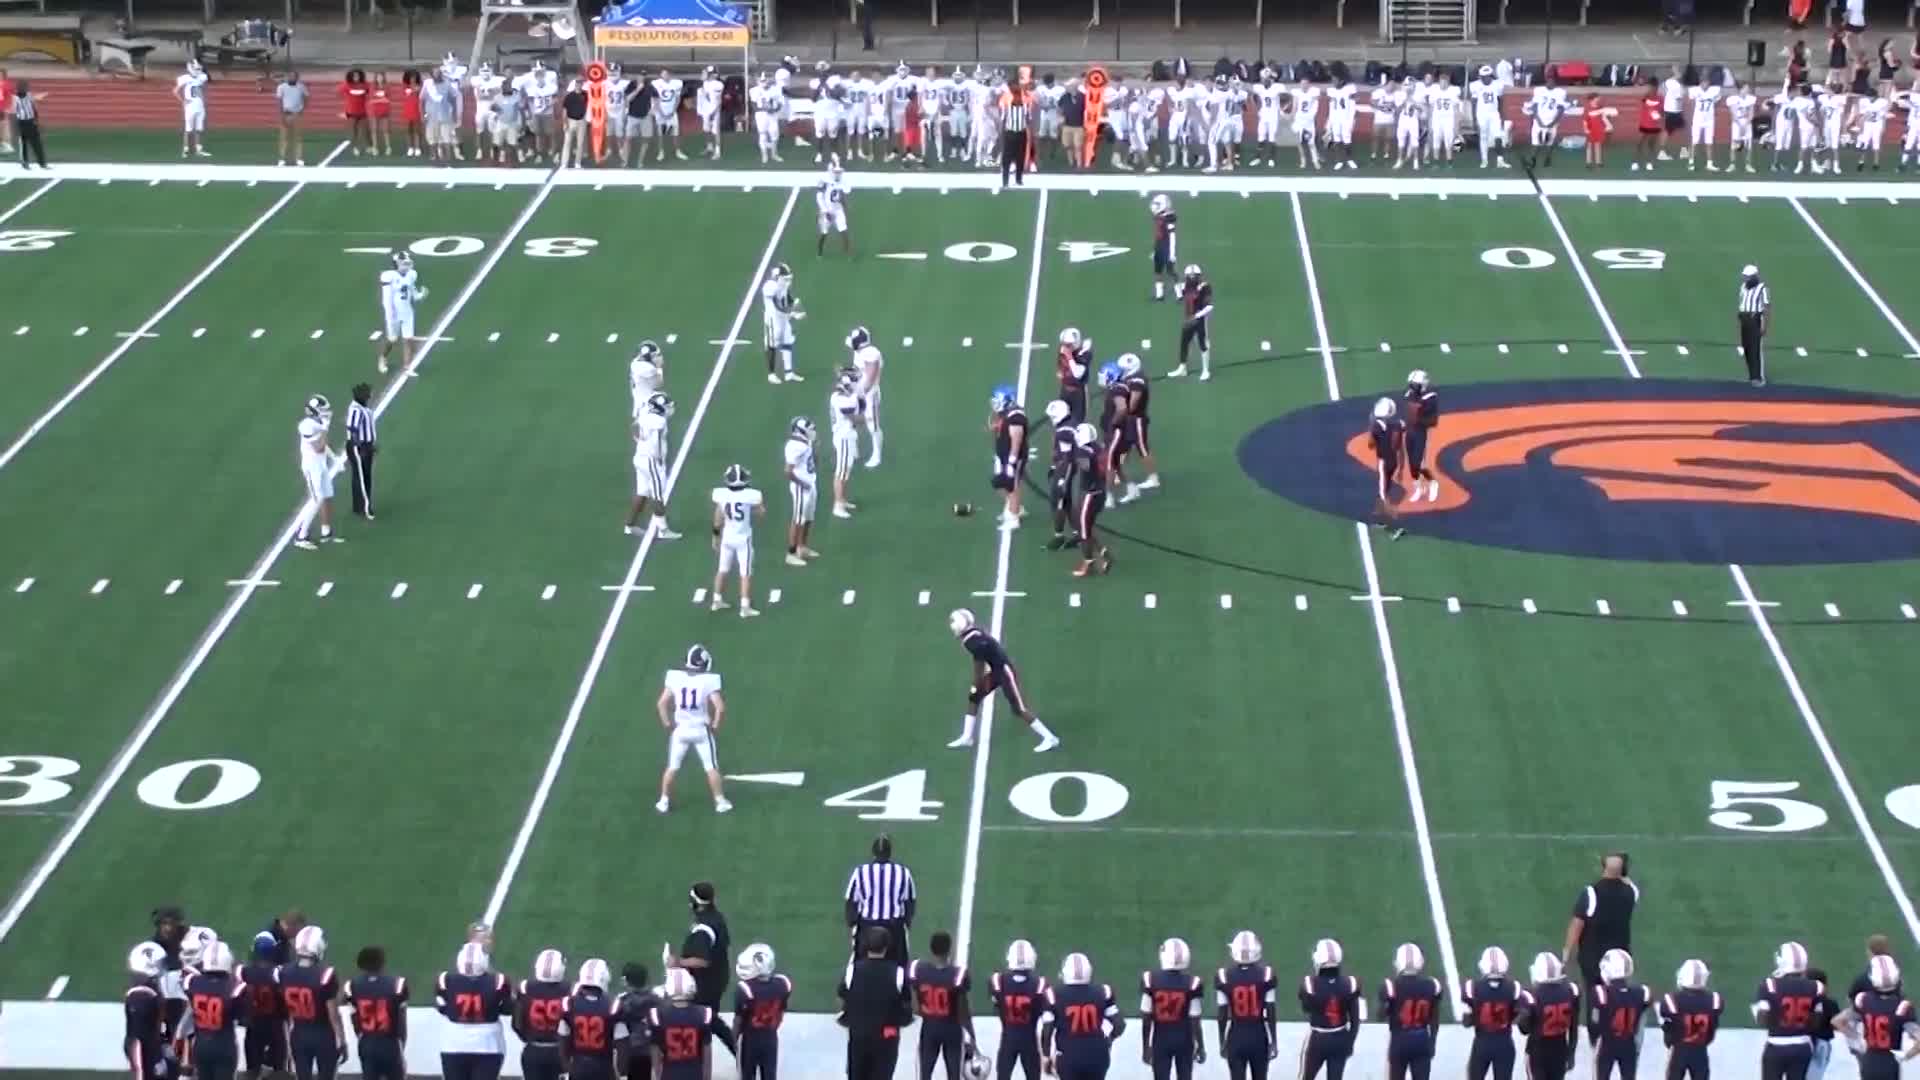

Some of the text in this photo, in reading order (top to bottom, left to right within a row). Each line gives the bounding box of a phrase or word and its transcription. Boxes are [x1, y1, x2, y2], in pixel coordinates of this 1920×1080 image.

[724, 501, 745, 522] 45
[679, 687, 700, 711] 11
[193, 993, 225, 1031] 58
[357, 999, 391, 1032] 54
[455, 992, 485, 1019] 71
[919, 984, 950, 1016] 30
[1154, 990, 1186, 1023] 27
[1232, 983, 1260, 1017] 81
[574, 1015, 605, 1049] 32
[1064, 1003, 1098, 1033] 70
[1865, 1013, 1891, 1048] 16
[665, 1026, 698, 1059] 53
